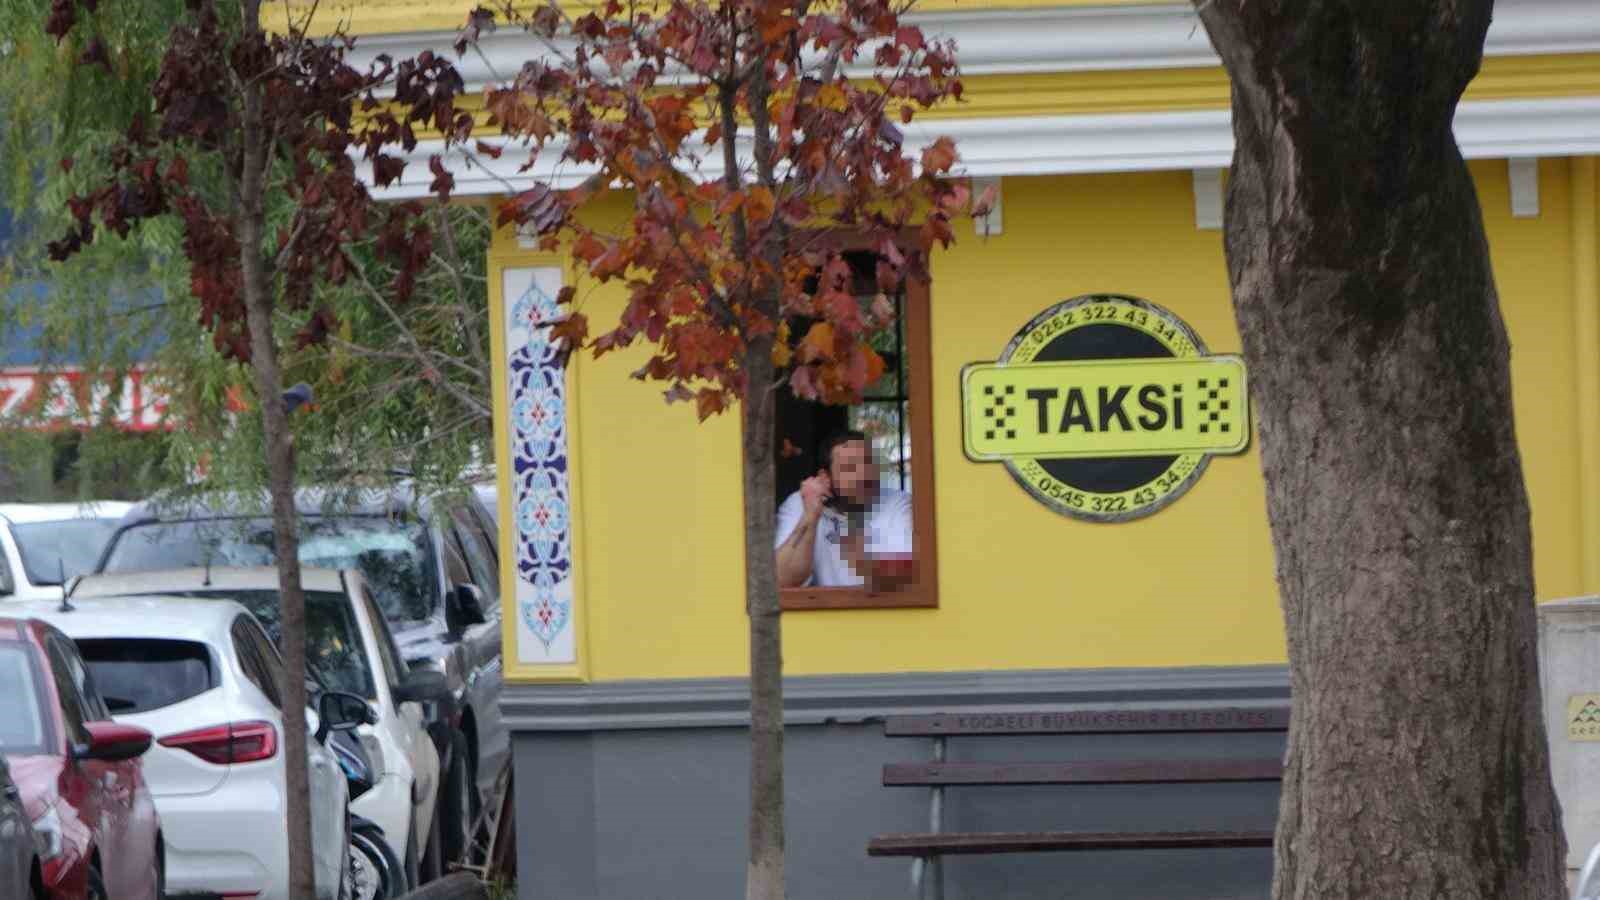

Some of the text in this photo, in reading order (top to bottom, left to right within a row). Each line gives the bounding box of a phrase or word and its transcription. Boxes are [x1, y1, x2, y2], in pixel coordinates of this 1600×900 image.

[1031, 305, 1177, 344] 0262 322 43 34
[1039, 470, 1179, 512] 0545 322 43 34
